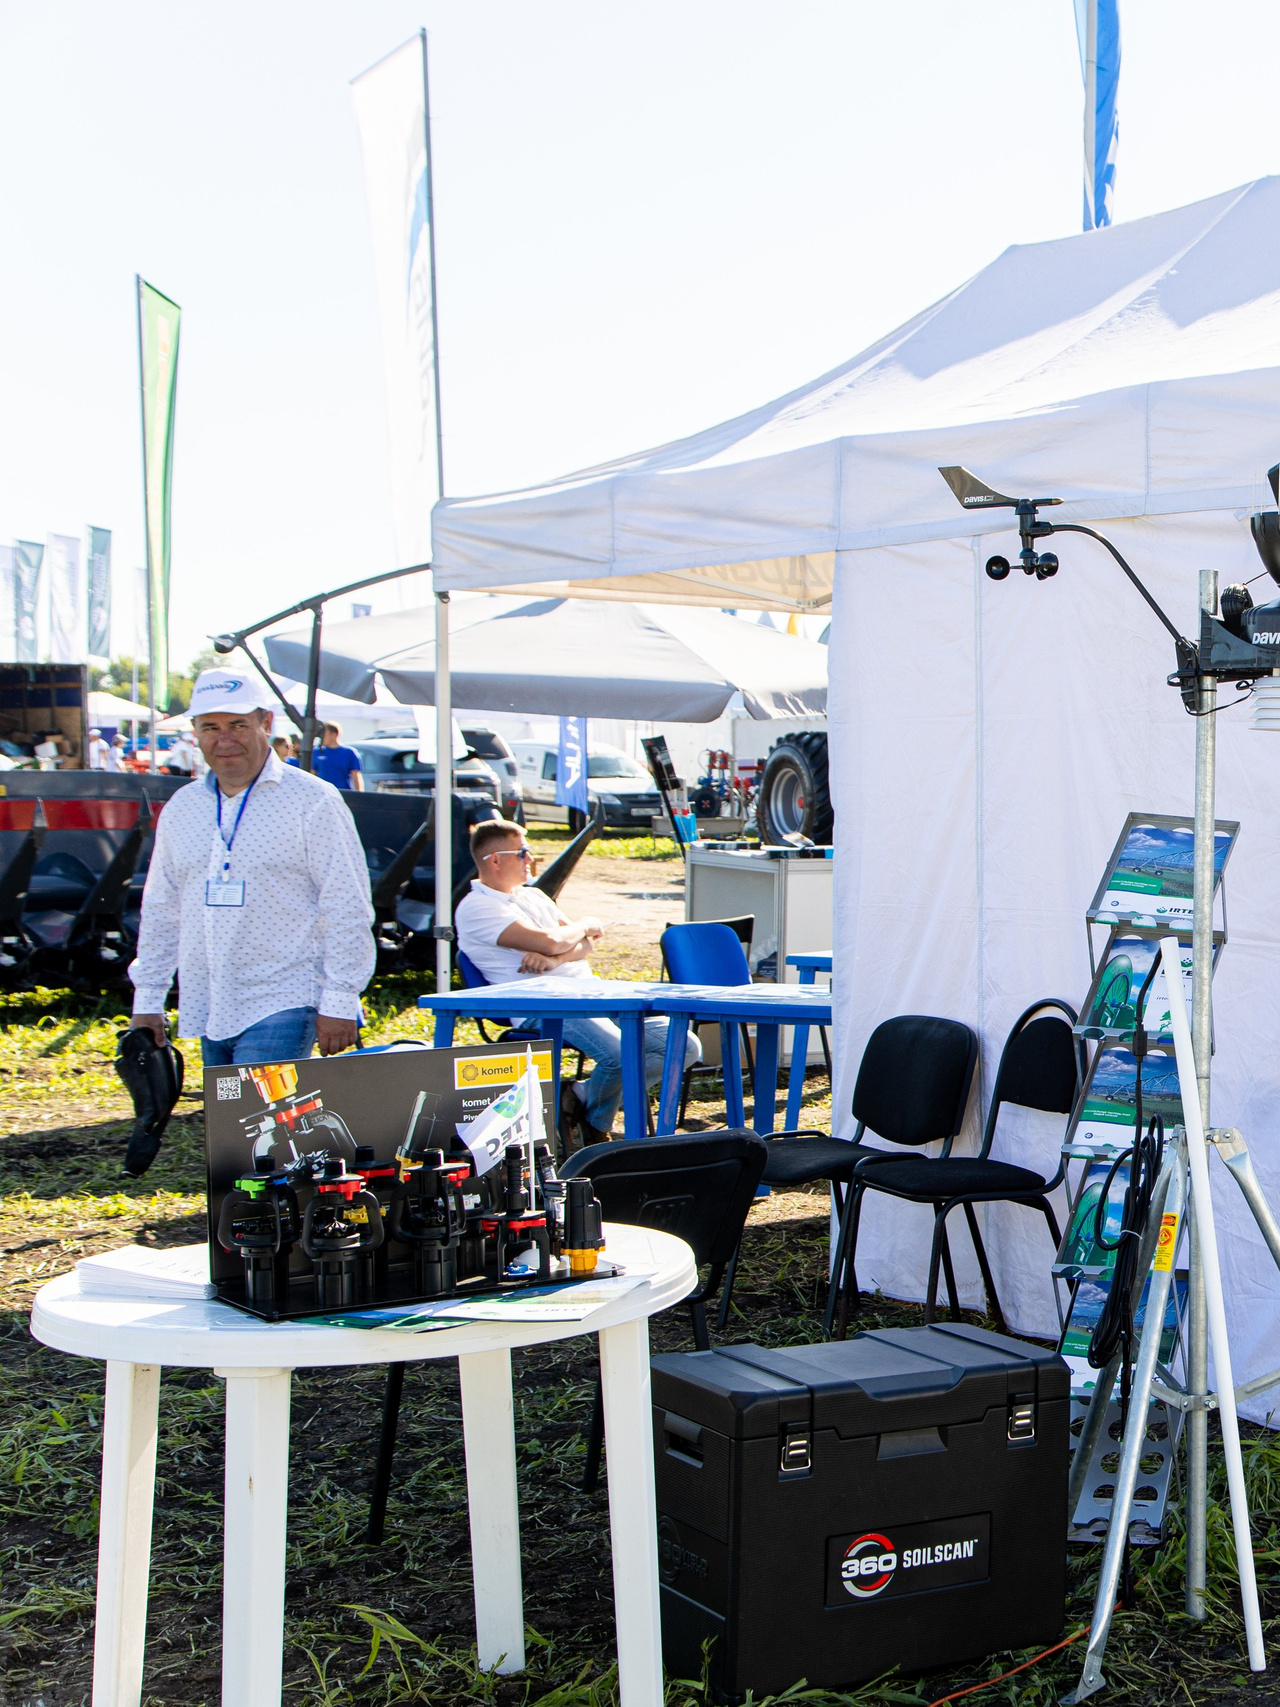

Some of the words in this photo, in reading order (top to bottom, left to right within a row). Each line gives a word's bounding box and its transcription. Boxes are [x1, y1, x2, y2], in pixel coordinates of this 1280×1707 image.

[482, 1065, 513, 1076] komet
[462, 1097, 491, 1107] komet
[841, 1553, 898, 1579] 360
